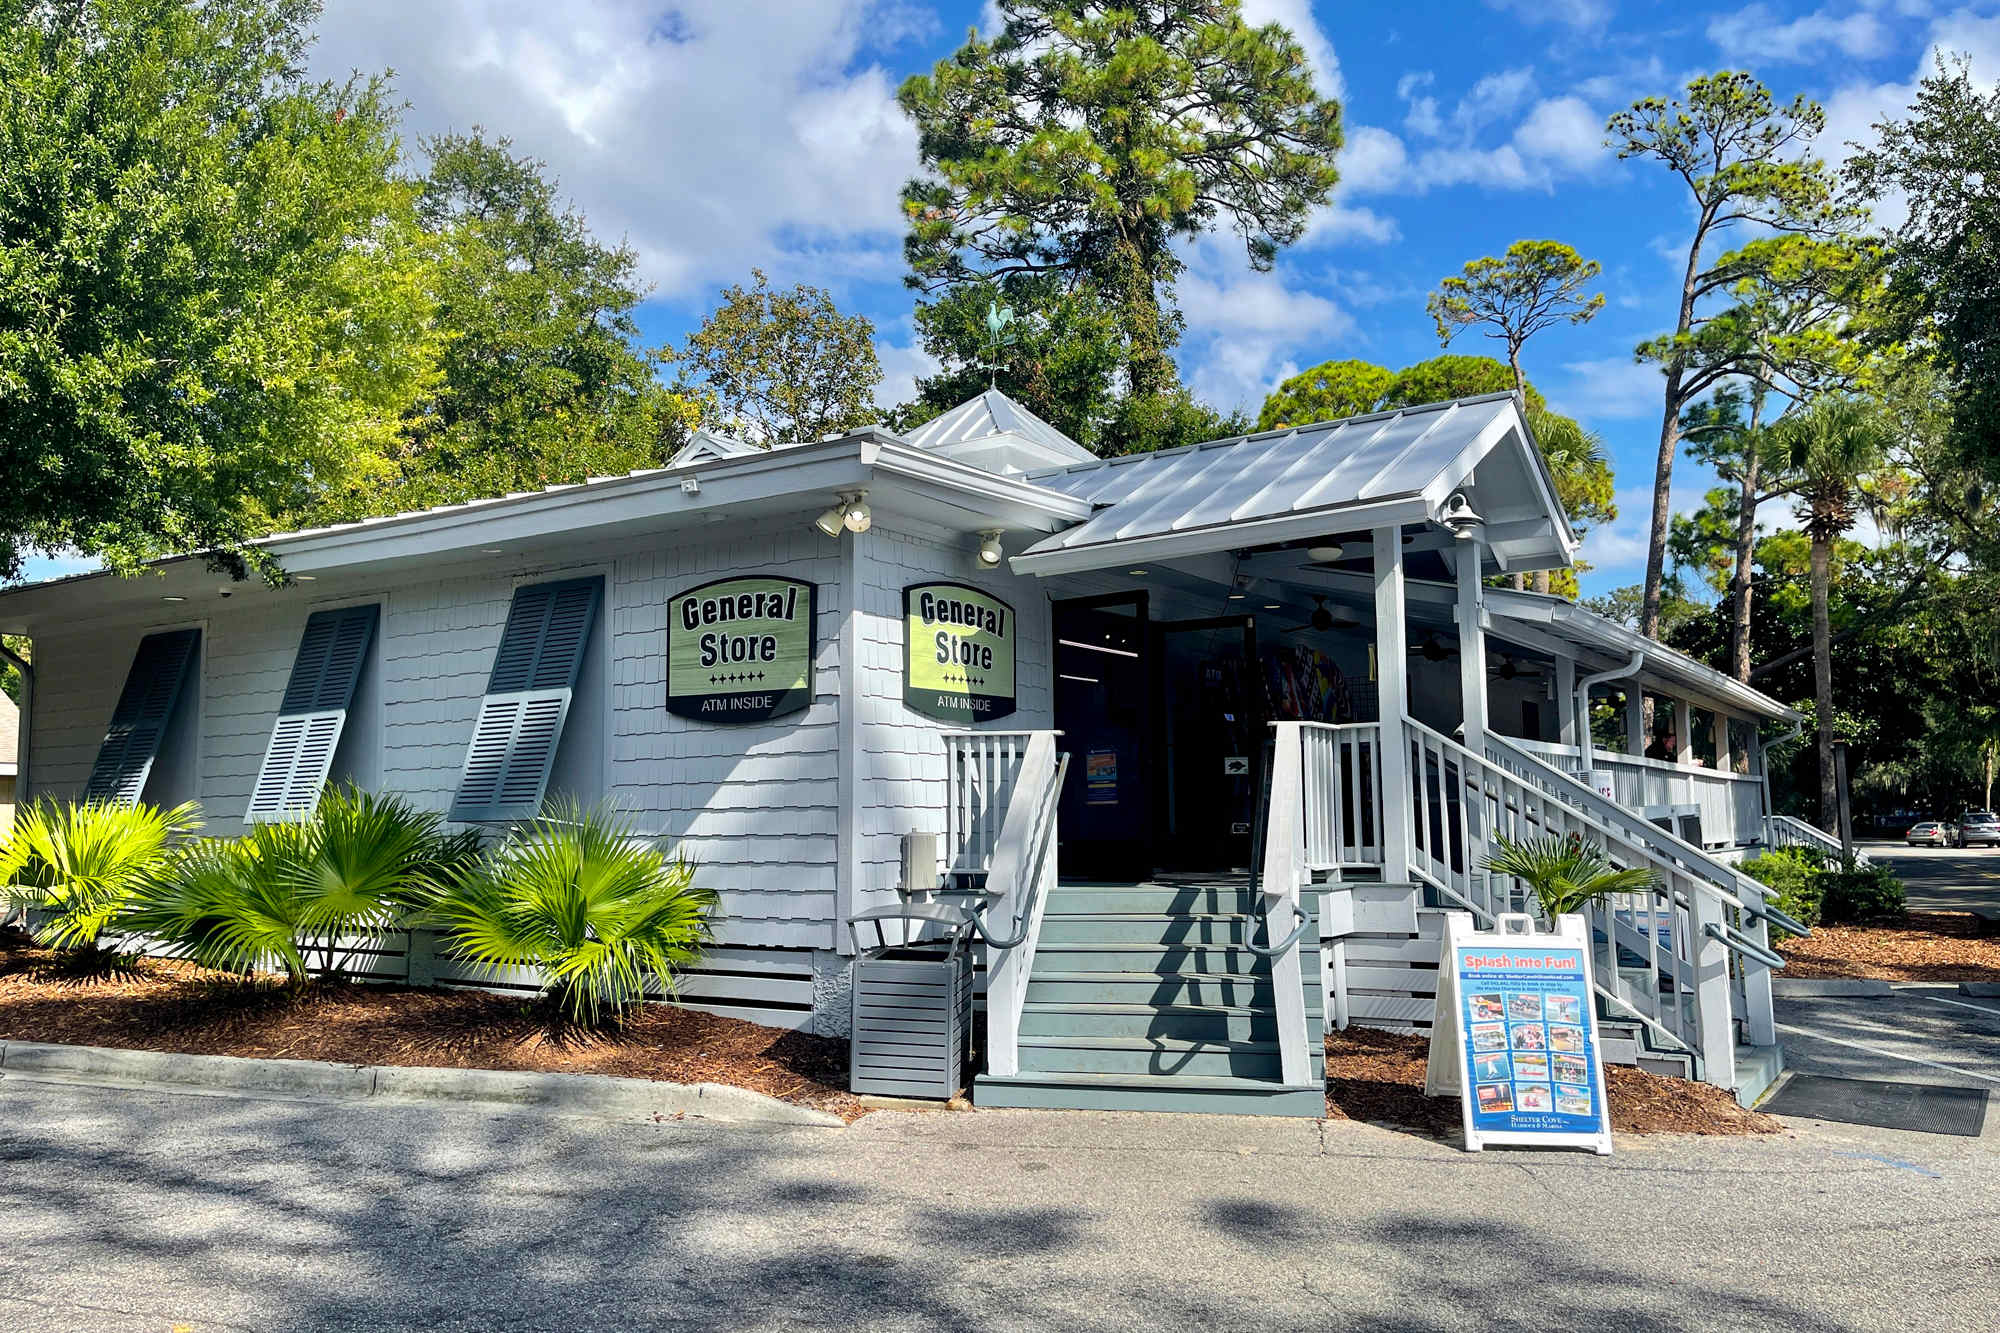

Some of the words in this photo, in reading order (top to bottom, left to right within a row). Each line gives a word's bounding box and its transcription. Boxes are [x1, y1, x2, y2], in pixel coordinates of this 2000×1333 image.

[681, 586, 797, 631] General
[920, 592, 1005, 638] General
[699, 632, 777, 668] Store
[935, 630, 993, 670] Store
[701, 698, 728, 712] ATM
[730, 695, 773, 710] INSIDE
[937, 695, 959, 709] ATM
[960, 697, 992, 712] INSIDE
[1464, 954, 1512, 971] Splash
[1515, 955, 1542, 968] into
[1545, 956, 1577, 969] Fun!
